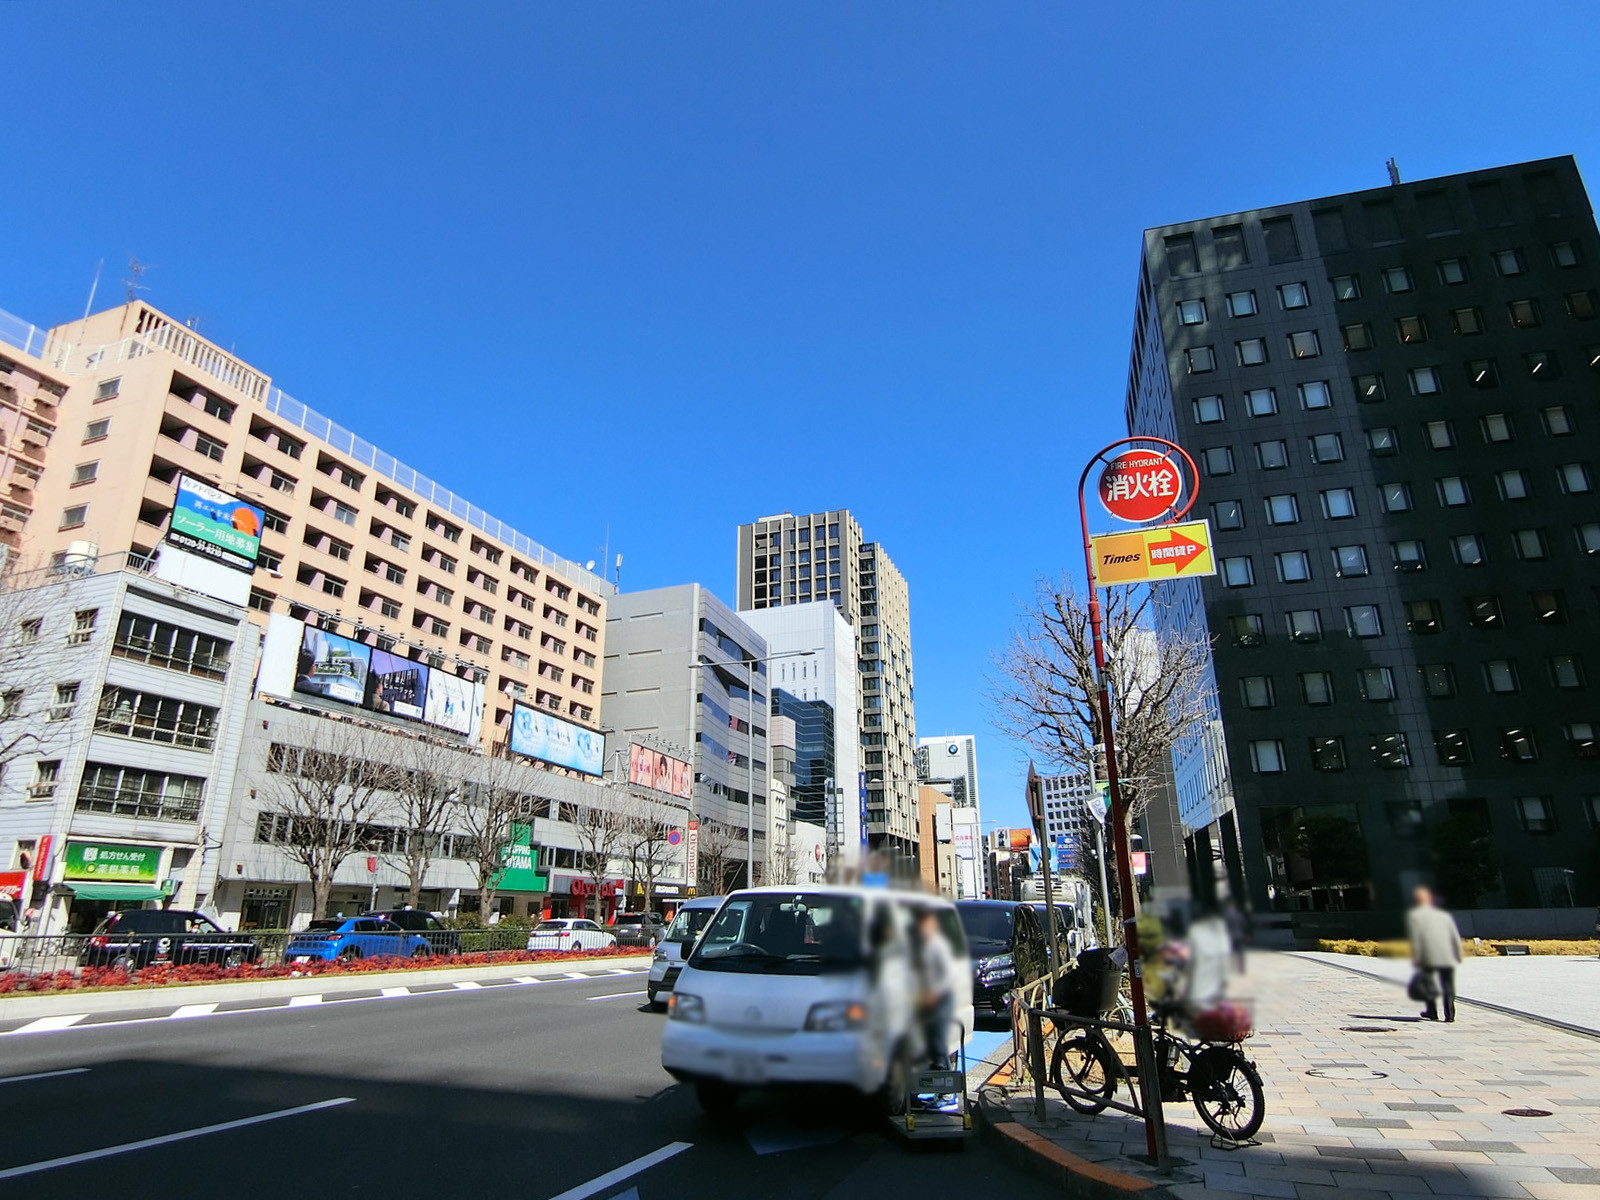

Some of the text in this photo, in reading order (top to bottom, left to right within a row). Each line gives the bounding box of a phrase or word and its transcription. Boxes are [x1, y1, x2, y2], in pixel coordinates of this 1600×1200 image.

[1110, 457, 1164, 470] FIRE HYDRANT
[1106, 469, 1174, 502] 消火栓
[177, 515, 256, 554] ソーラー用地募集
[1103, 552, 1141, 565] Times
[1150, 544, 1197, 559] 時間貸P
[689, 833, 697, 878] Olympic
